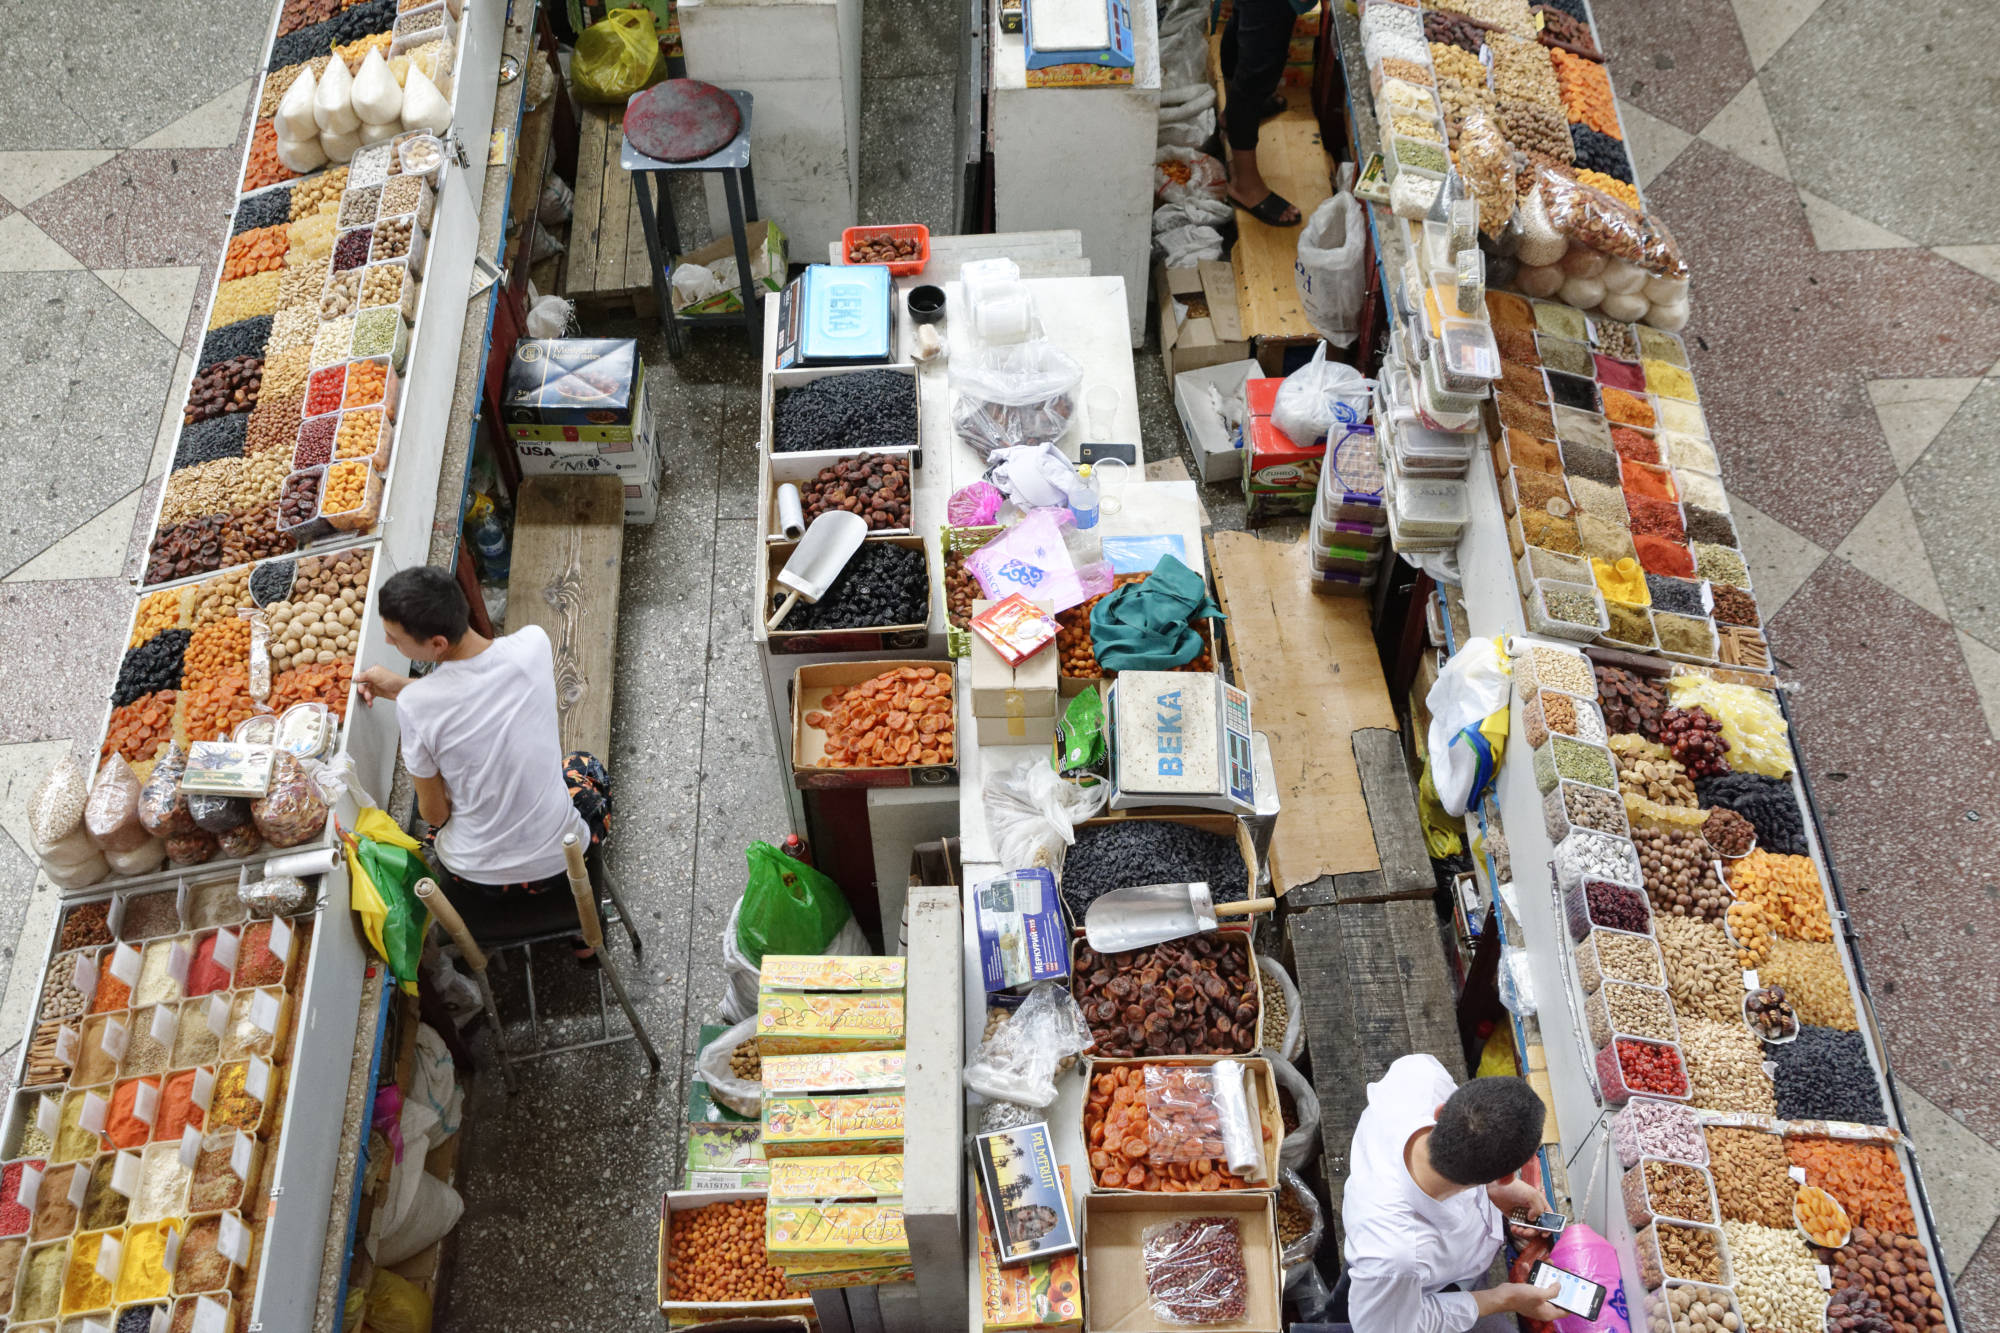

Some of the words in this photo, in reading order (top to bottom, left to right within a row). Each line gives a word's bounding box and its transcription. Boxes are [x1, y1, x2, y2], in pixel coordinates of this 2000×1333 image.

[520, 446, 555, 457] USA
[1157, 689, 1183, 777] BEKA
[696, 1182, 736, 1190] RAISINS
